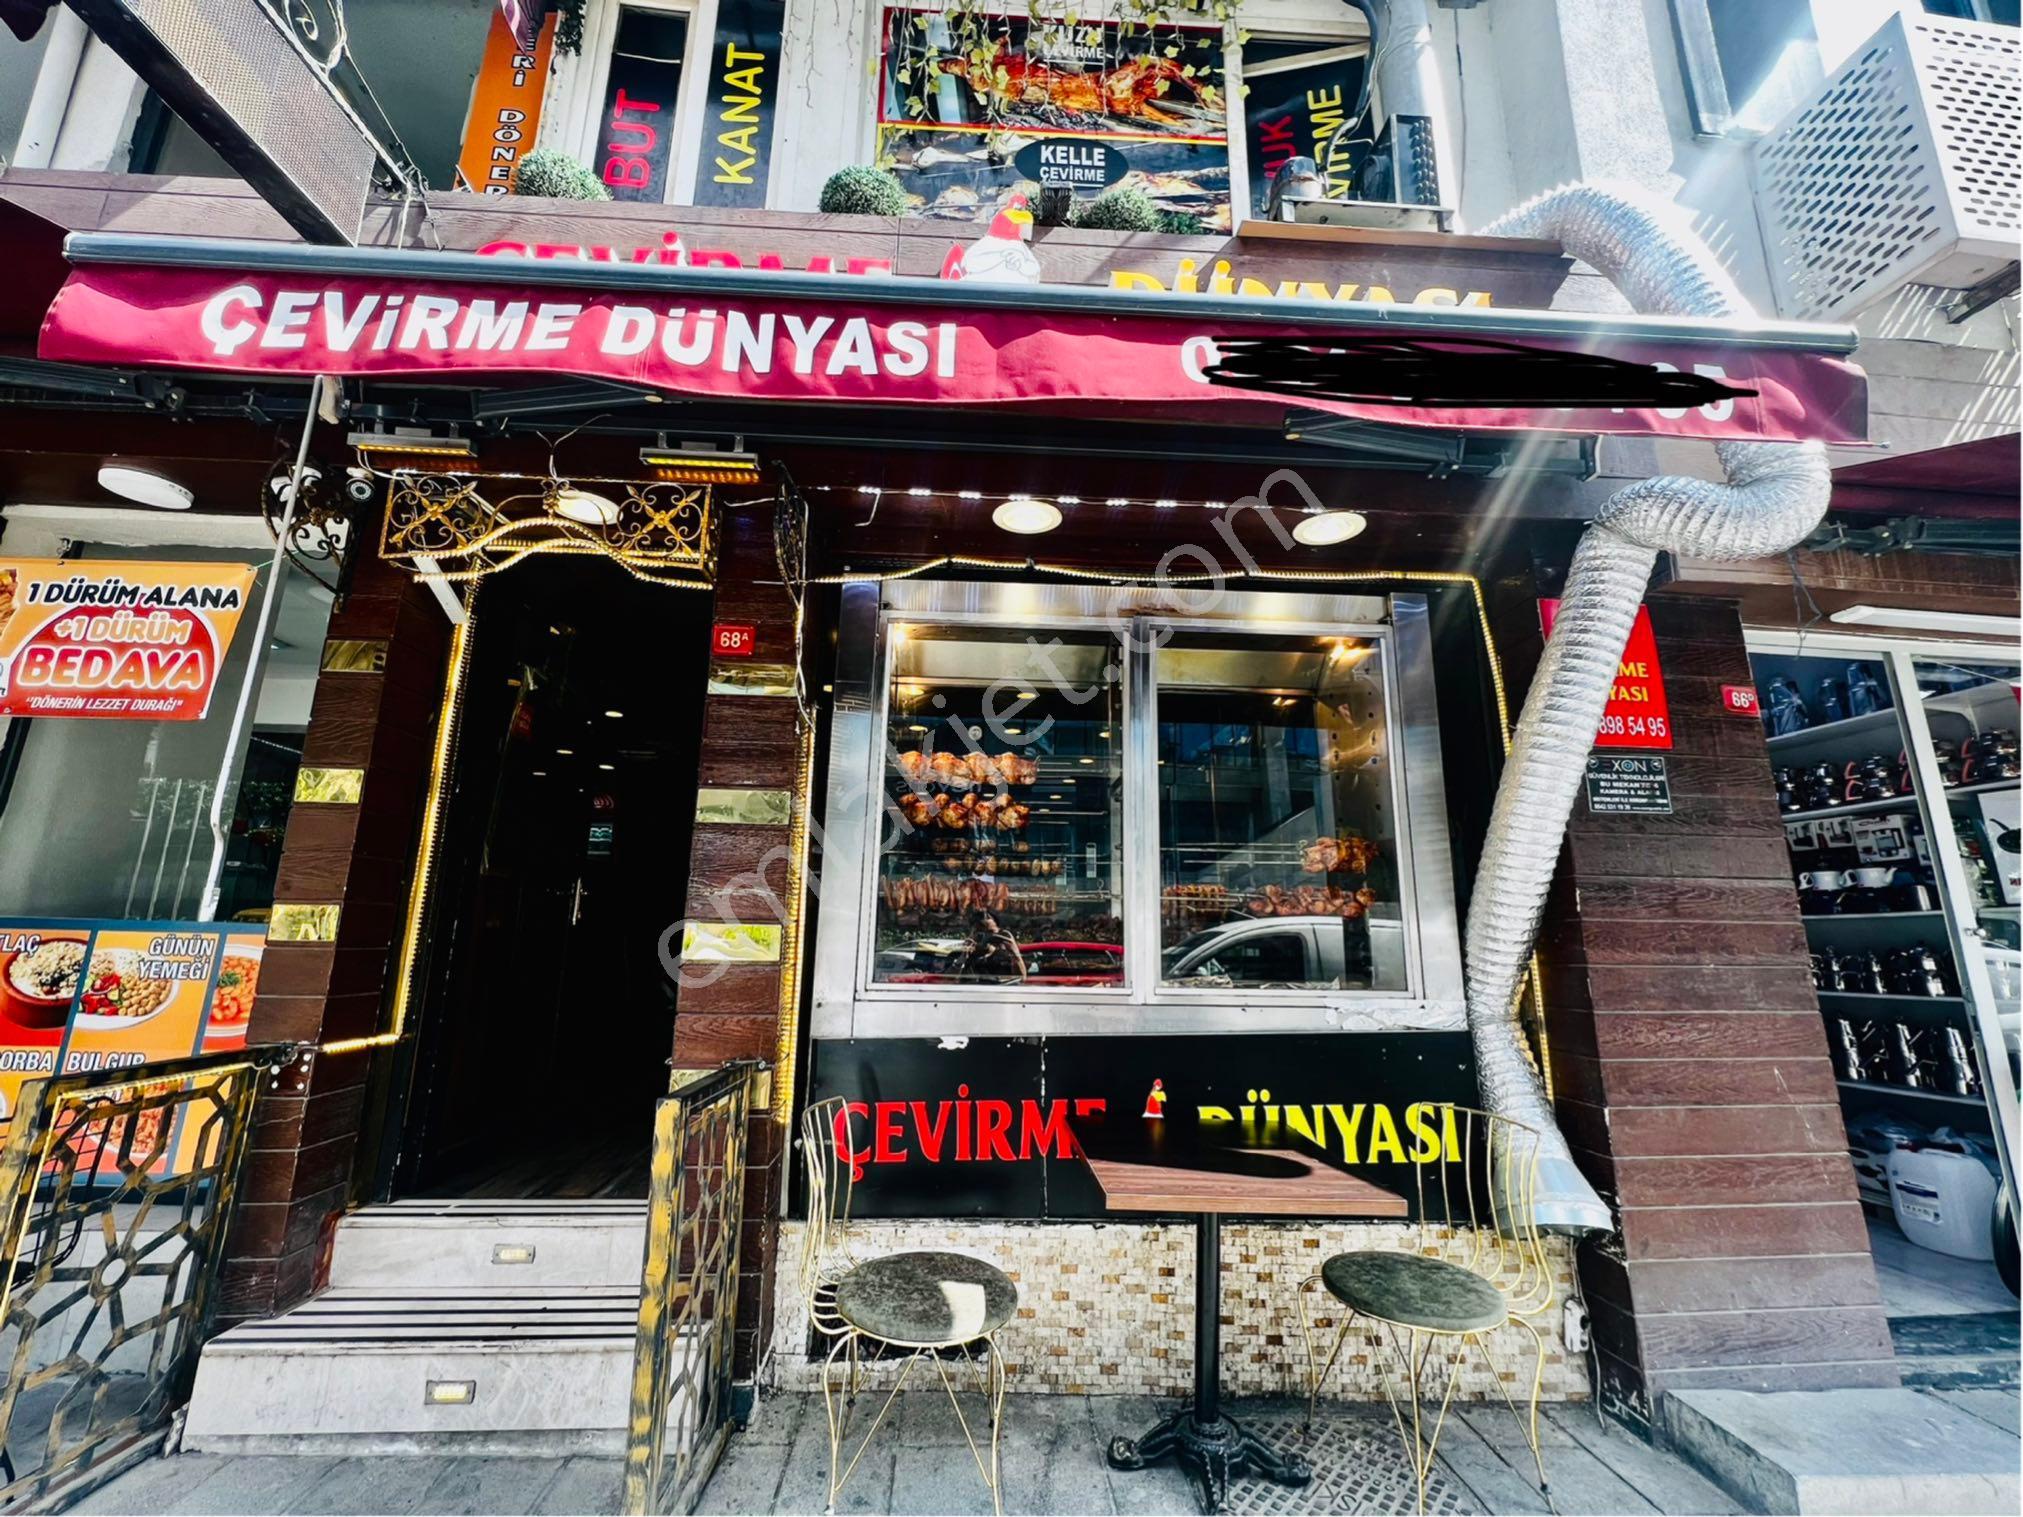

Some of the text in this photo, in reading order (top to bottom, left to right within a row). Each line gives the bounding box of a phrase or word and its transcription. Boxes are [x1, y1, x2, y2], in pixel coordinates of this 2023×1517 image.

[712, 42, 766, 185] KANAT
[602, 88, 661, 189] BUT
[1040, 144, 1105, 167] KELLE
[600, 305, 957, 379] DÜNYASI
[28, 577, 240, 609] 1 DÜRÜM ALANA
[54, 610, 193, 645] +1 DÜRÜM
[18, 644, 206, 690] BEDAVA
[1617, 661, 1649, 678] ME
[86, 697, 130, 711] LEZZET
[1627, 716, 1645, 736] 54
[1647, 716, 1666, 737] 95
[149, 934, 216, 957] GÜNÜN
[137, 957, 211, 981] YEMEĞİ
[0, 1050, 53, 1072] ORBA
